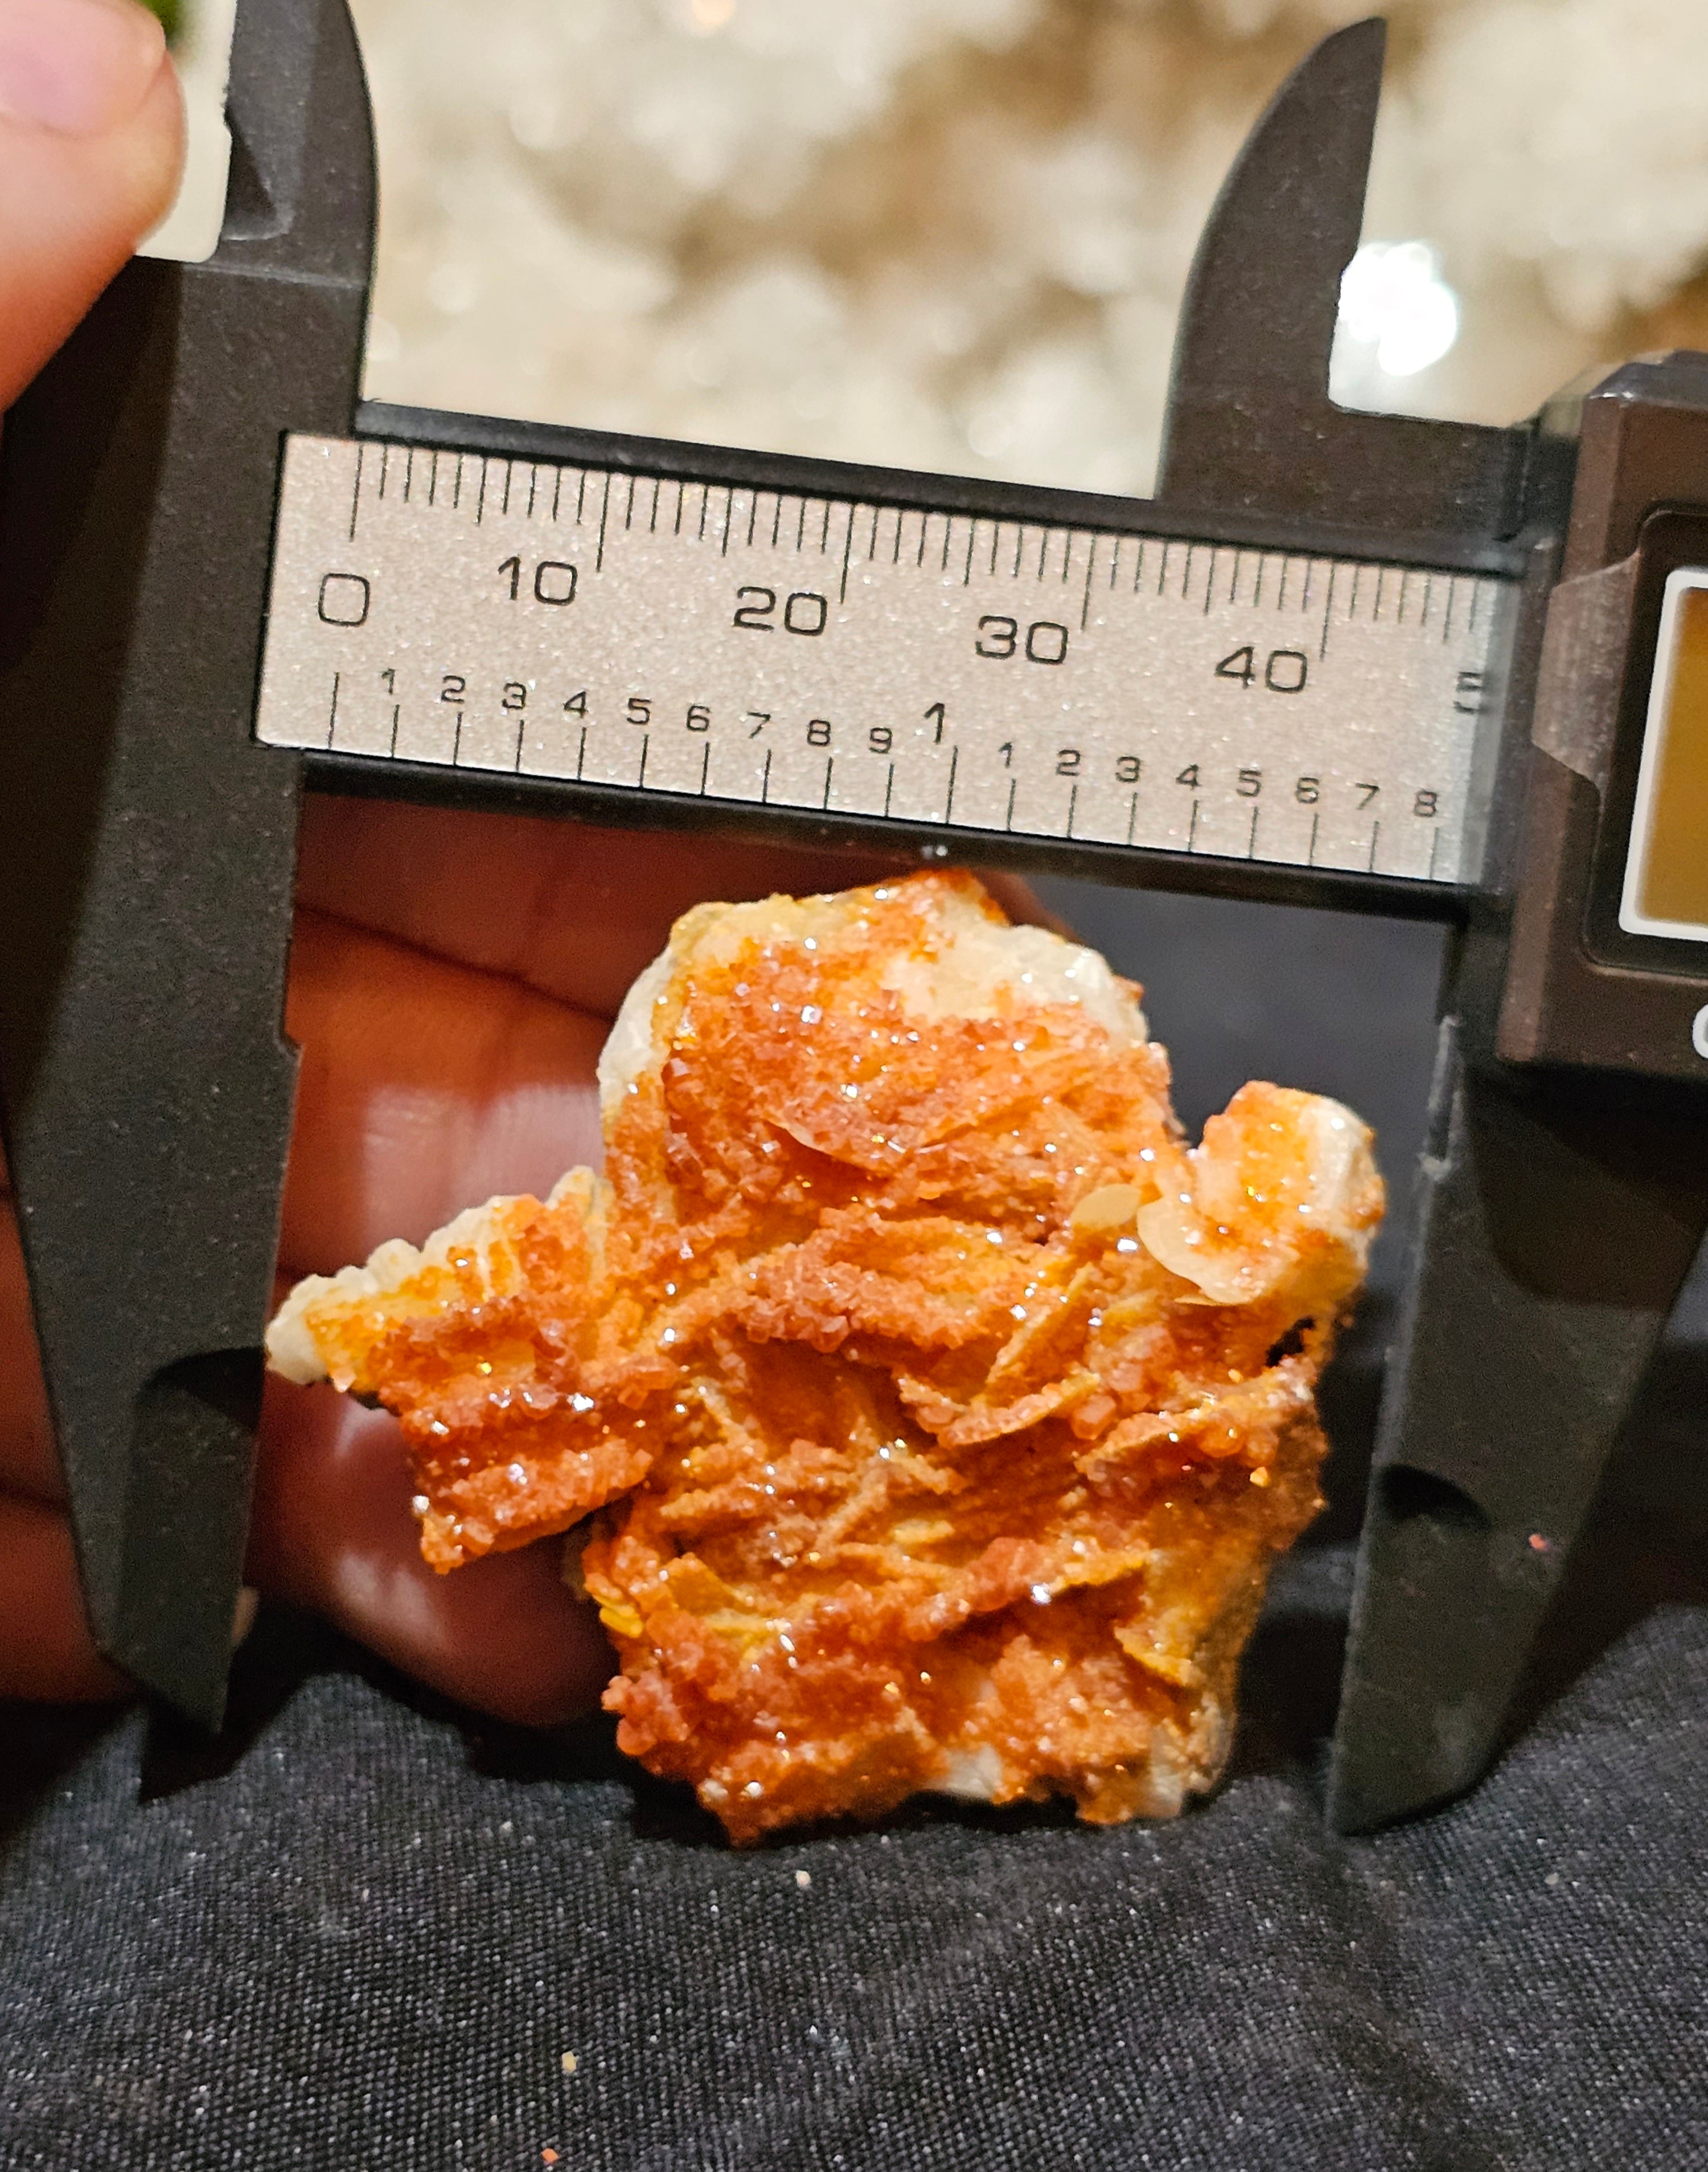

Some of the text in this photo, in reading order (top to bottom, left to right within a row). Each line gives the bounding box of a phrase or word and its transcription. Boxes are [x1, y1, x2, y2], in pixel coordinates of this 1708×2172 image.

[316, 571, 372, 629] 0
[496, 554, 579, 608] 10
[731, 585, 829, 638] 20
[974, 614, 1070, 667] 30
[1213, 645, 1309, 695] 40
[380, 667, 1440, 819] 1 2 3 4 5 6 7 8 9 1 1 2 3 4 5 6 7 8
